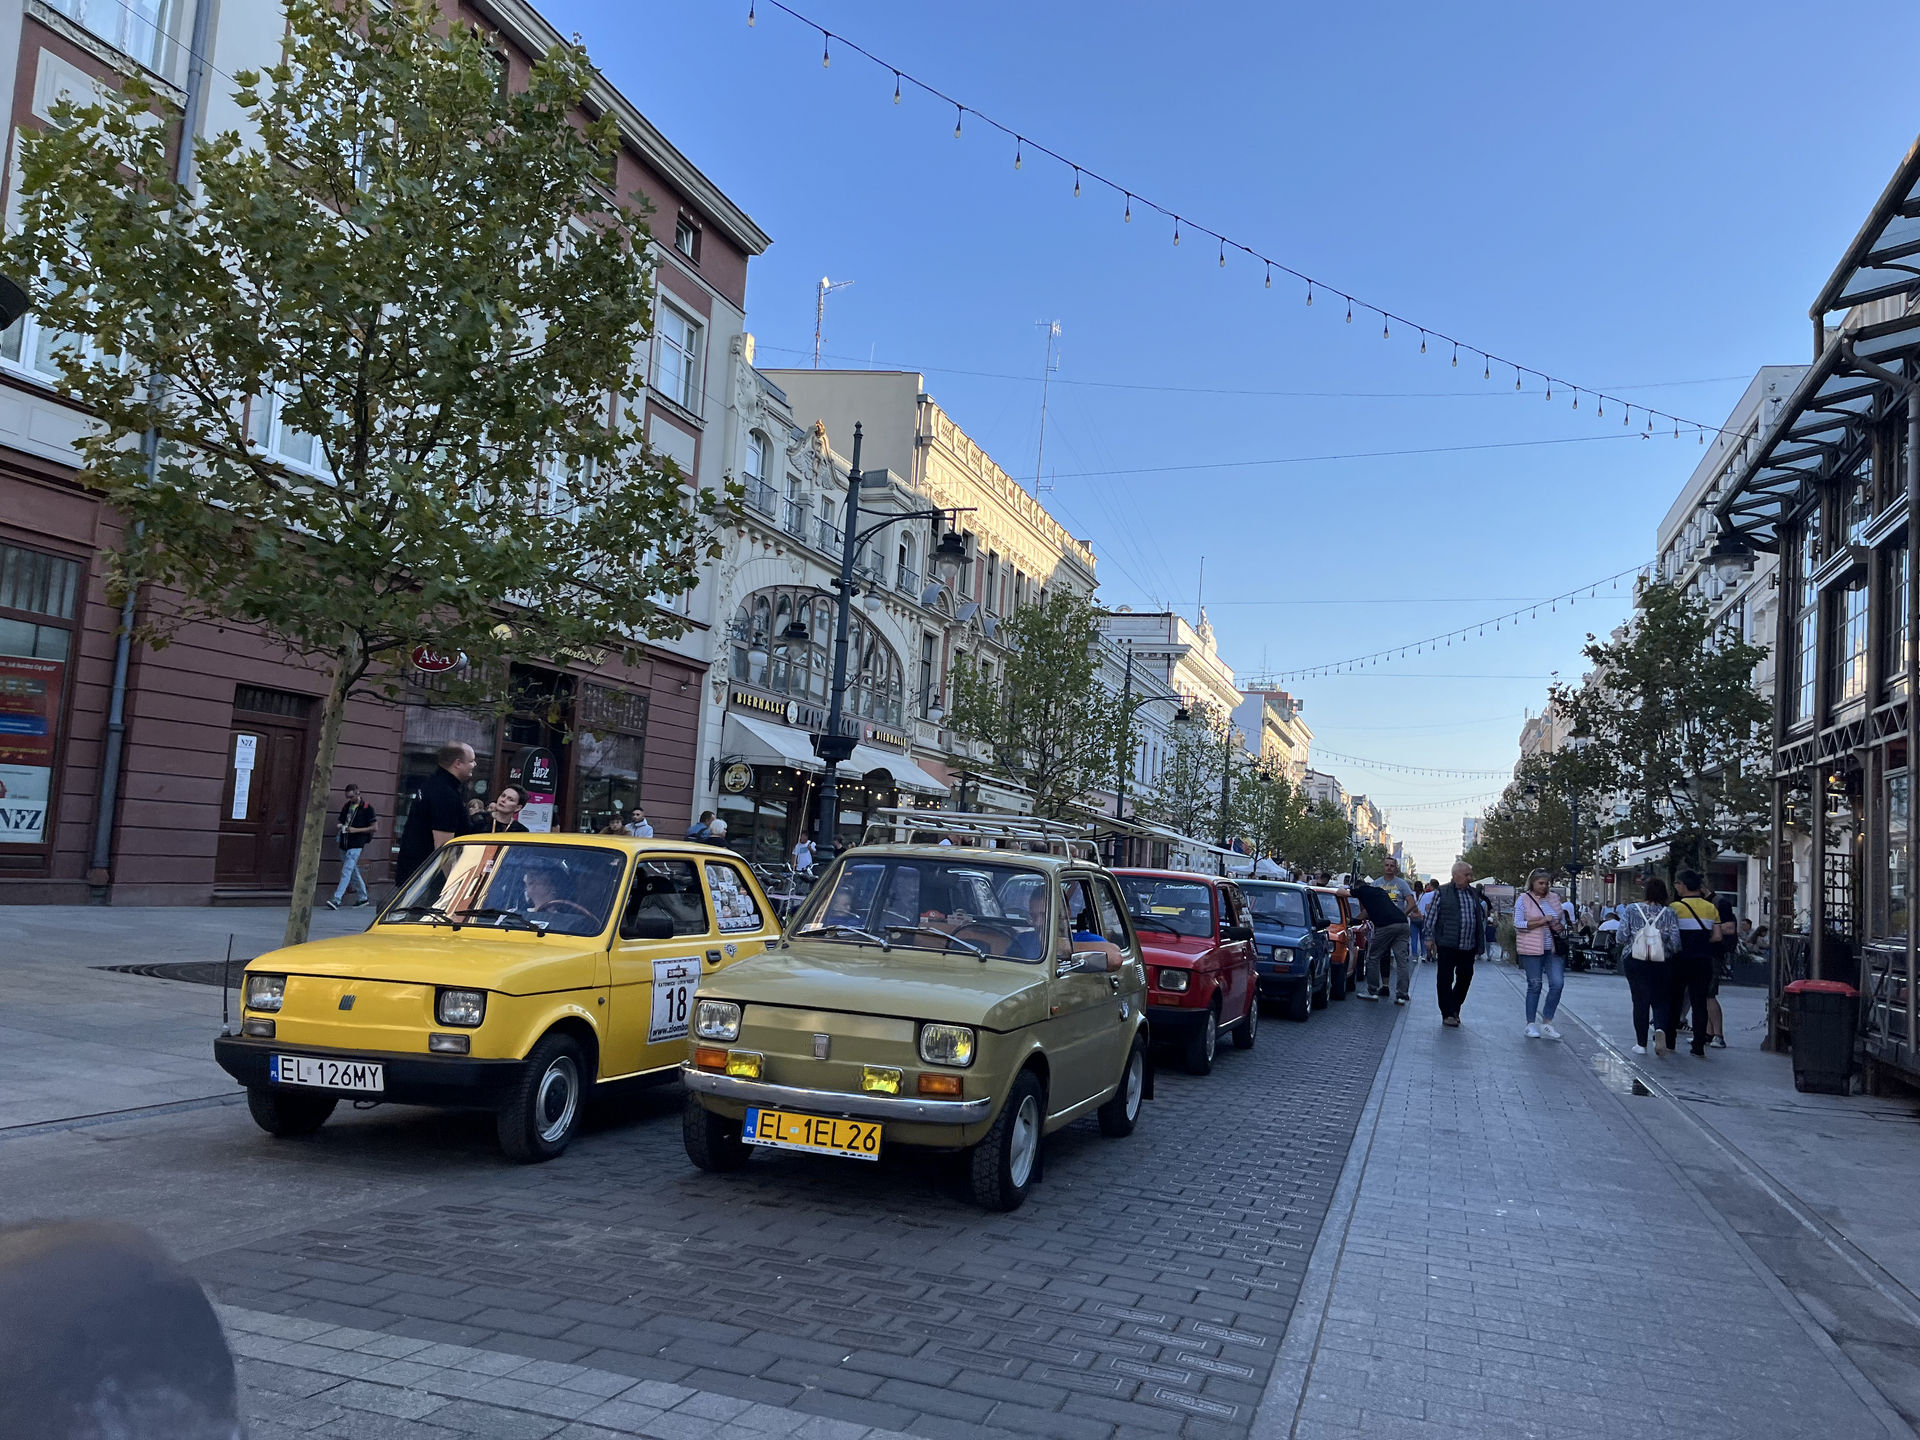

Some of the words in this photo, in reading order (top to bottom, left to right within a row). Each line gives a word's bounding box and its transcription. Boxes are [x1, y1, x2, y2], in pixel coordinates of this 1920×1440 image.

[736, 692, 785, 715] BIERHALLE
[876, 730, 907, 748] BIERHALLE
[666, 987, 686, 1022] 18
[281, 1058, 308, 1083] EL
[317, 1062, 380, 1089] 126MY
[747, 1126, 754, 1134] PL
[759, 1112, 788, 1141] EL
[803, 1118, 878, 1152] 1EL26
